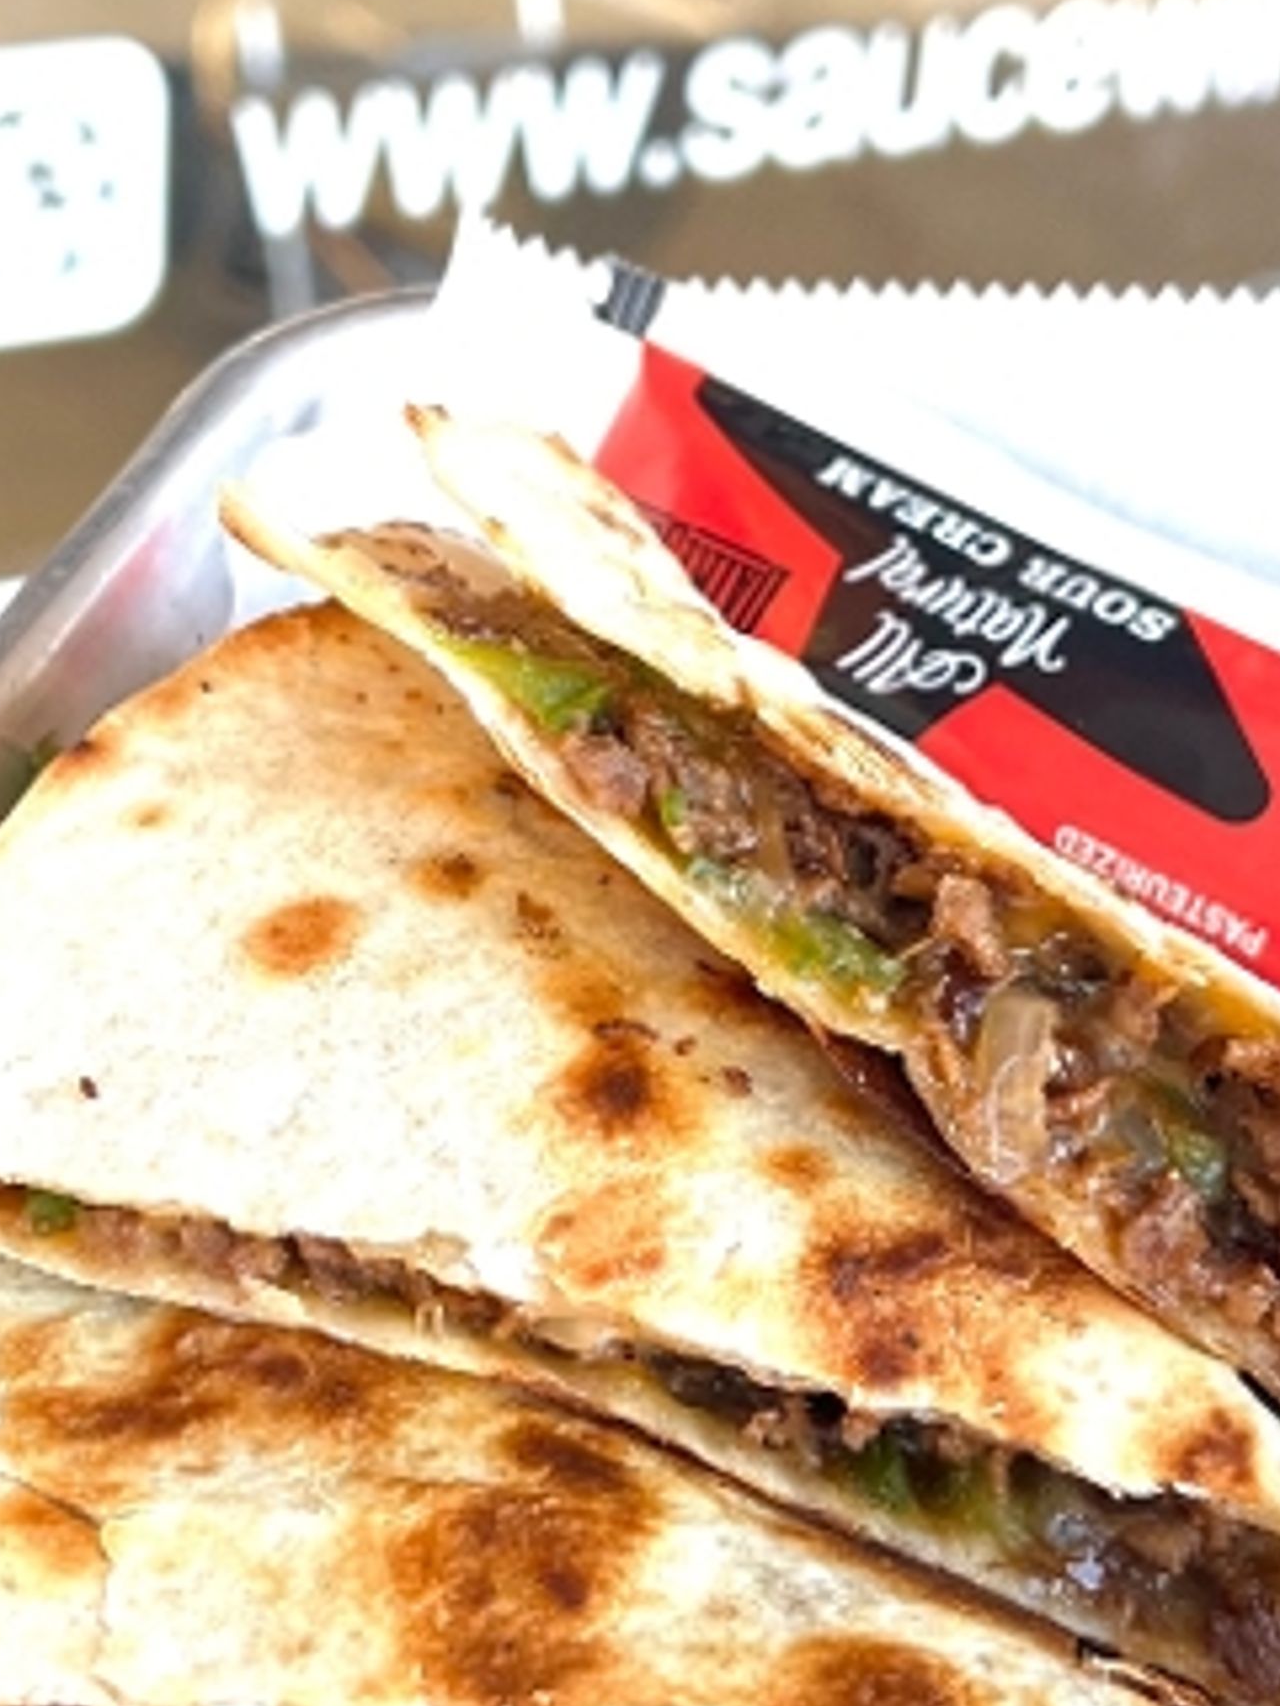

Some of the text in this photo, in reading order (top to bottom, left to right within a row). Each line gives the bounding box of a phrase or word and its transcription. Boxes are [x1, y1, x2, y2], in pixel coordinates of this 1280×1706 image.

[816, 455, 1181, 642] SOUR CREAM
[843, 533, 1072, 673] Natural
[834, 611, 988, 694] All
[1054, 824, 1268, 957] PASTEURIZED
